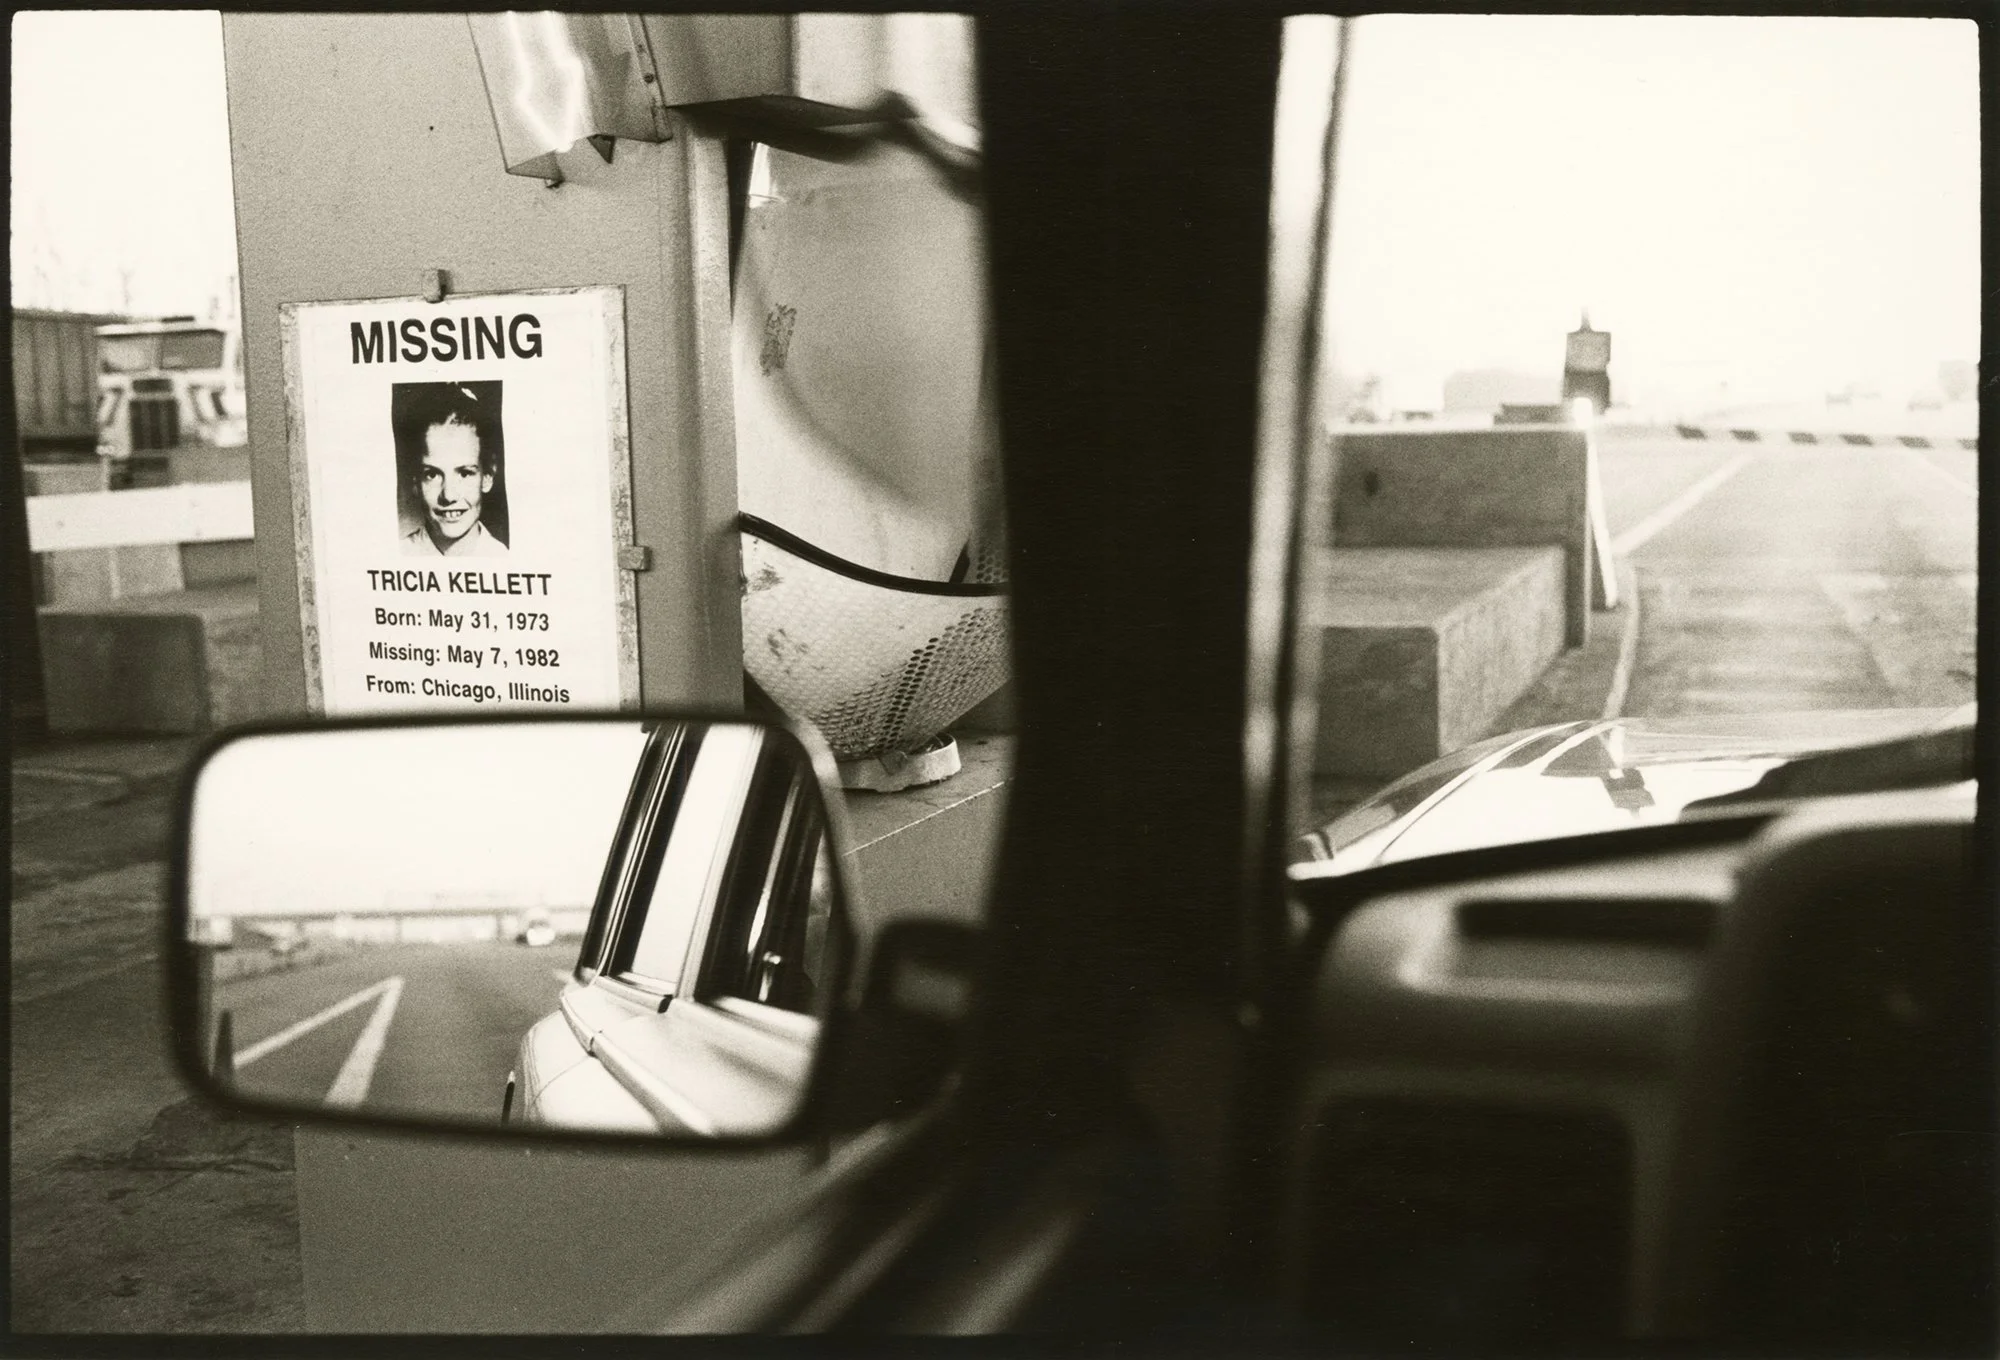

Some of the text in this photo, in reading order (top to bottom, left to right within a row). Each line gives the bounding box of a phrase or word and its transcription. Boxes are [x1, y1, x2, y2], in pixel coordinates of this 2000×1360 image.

[350, 313, 543, 364] MISSING
[367, 569, 552, 596] TRICIA KELLETT
[375, 607, 550, 633] Born: May 31, 1973
[369, 641, 560, 669] Missing: May 7, 1982
[366, 675, 570, 703] From: Chicago, Illinois
